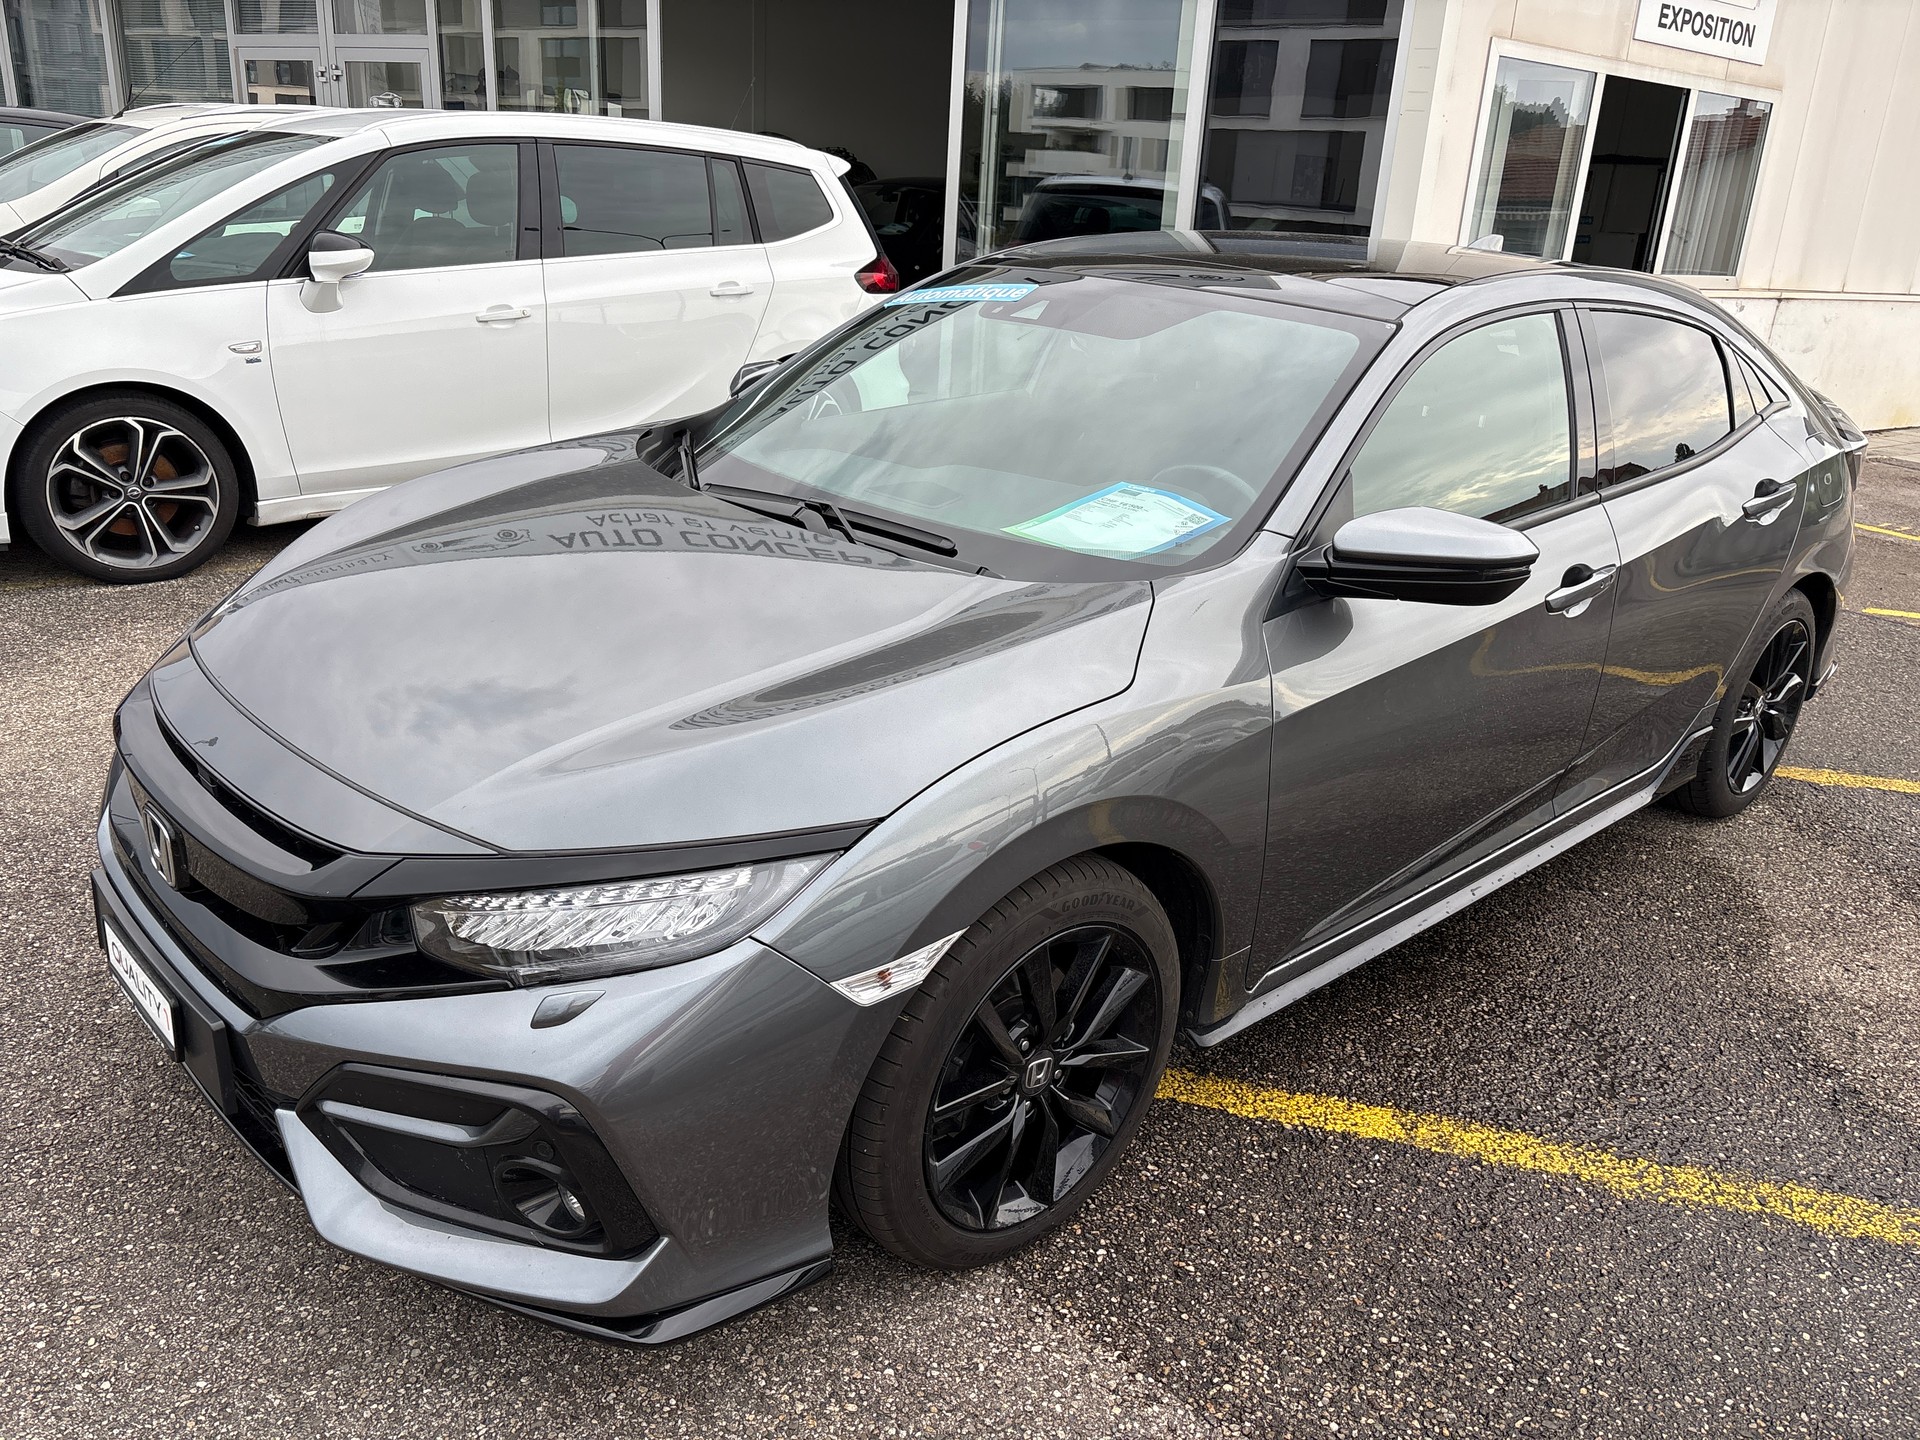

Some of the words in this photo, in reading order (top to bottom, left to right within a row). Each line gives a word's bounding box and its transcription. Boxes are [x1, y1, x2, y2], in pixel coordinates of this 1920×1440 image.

[1657, 3, 1757, 48] EXPOSITION
[892, 285, 1029, 302] Automatique
[1061, 891, 1135, 913] GOODYEAR
